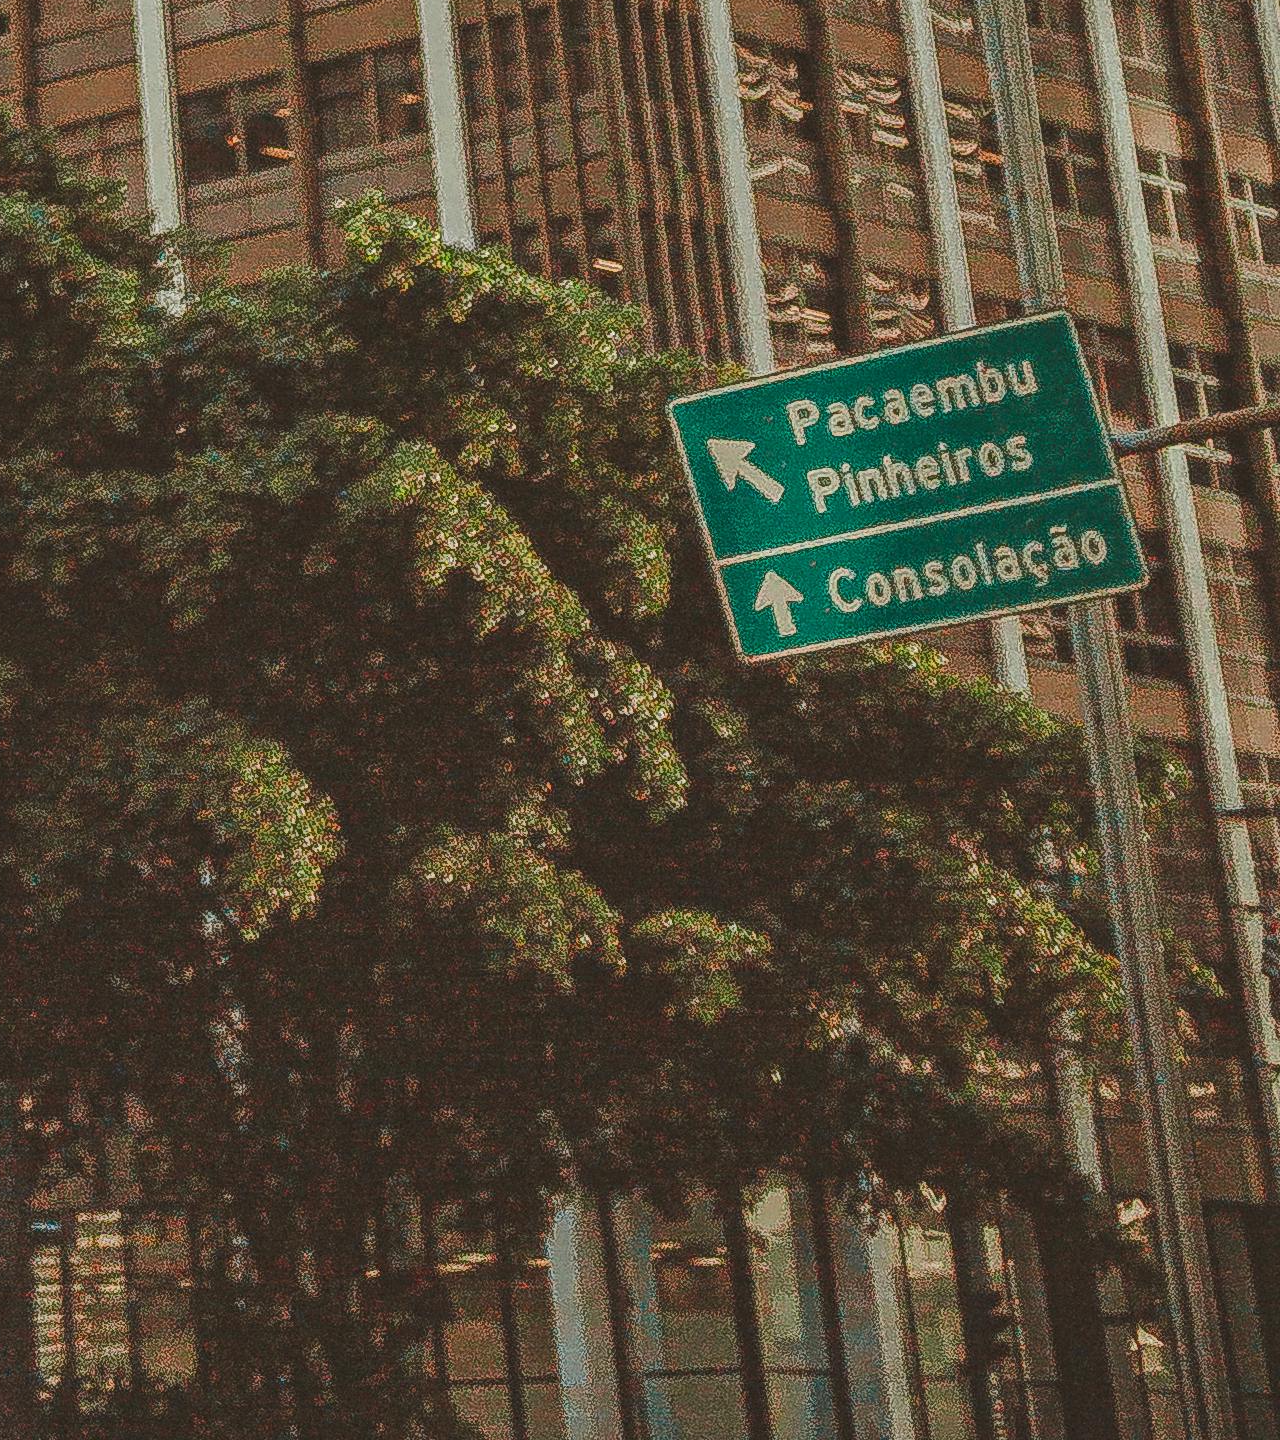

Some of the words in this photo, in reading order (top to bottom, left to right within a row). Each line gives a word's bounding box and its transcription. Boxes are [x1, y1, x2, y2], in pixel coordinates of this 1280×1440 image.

[786, 360, 1038, 445] Pacaembu
[806, 434, 1032, 513] Pinheiros
[828, 526, 1107, 613] Consolação
